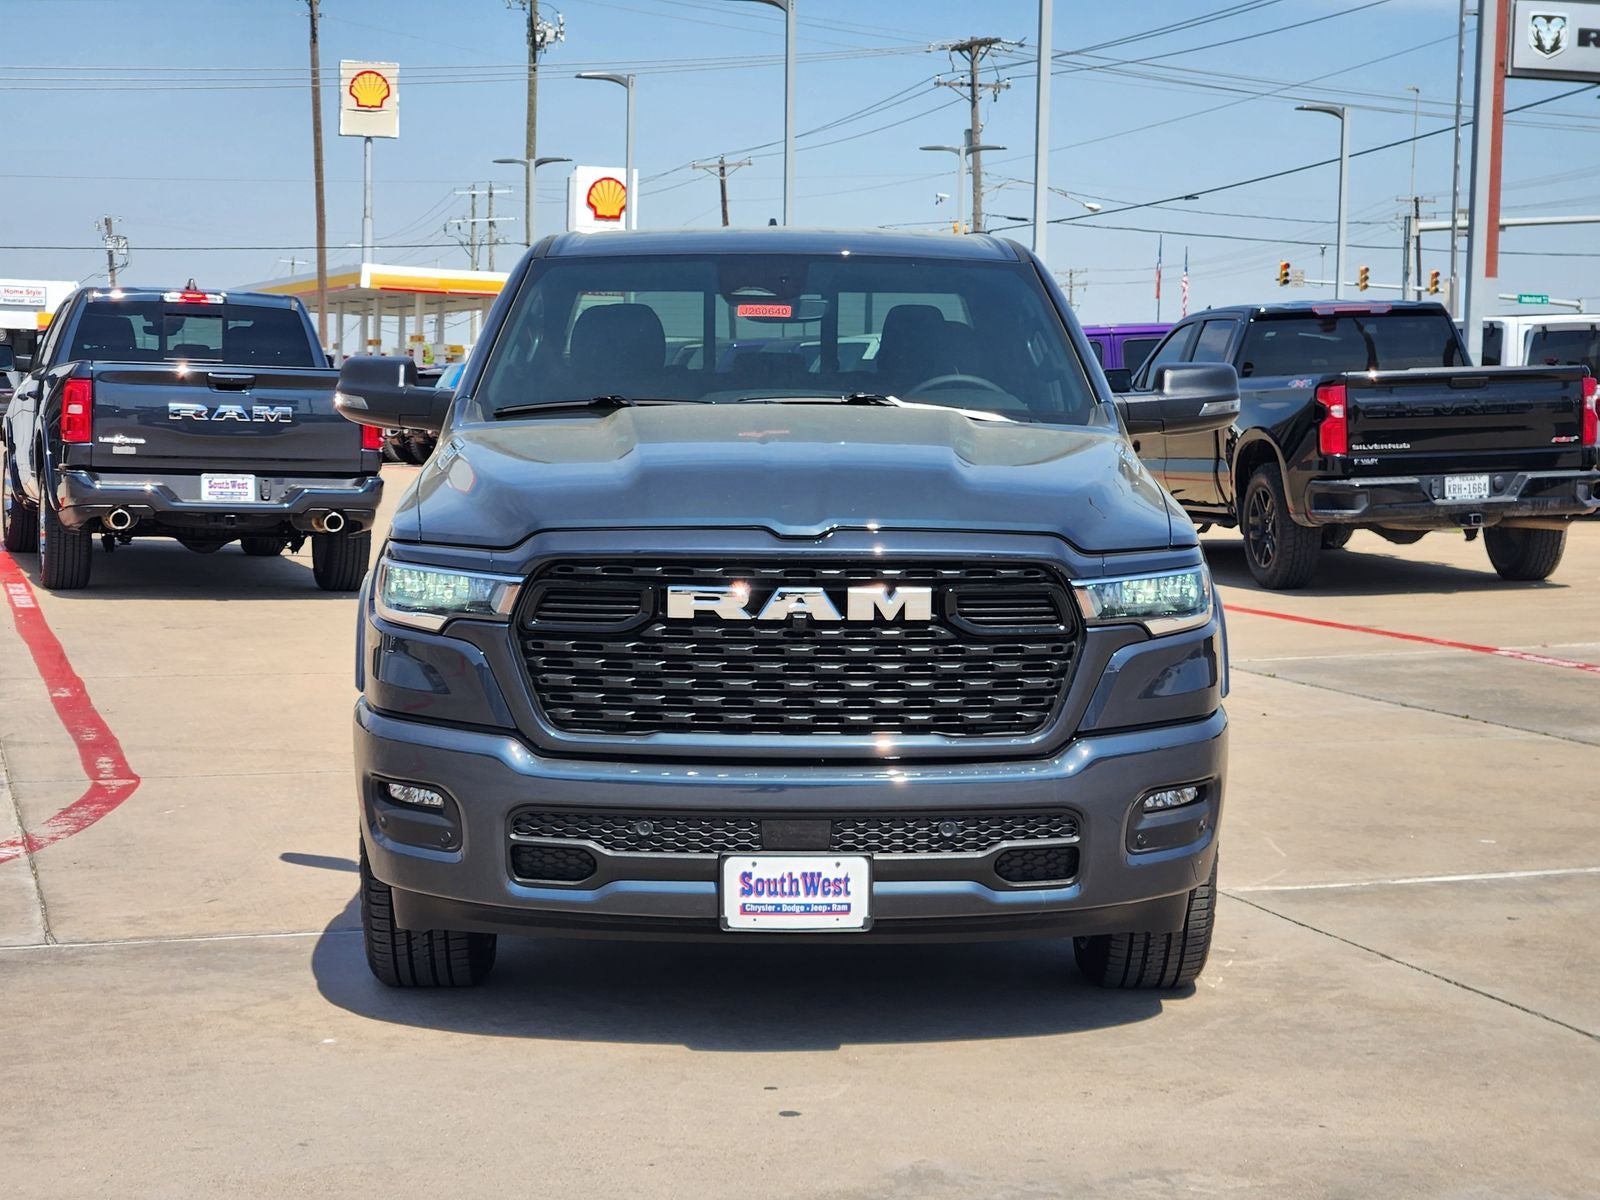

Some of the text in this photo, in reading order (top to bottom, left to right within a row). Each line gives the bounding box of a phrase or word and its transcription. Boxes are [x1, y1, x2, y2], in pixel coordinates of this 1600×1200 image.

[168, 402, 292, 423] RAM
[667, 585, 932, 621] RAM
[745, 904, 775, 913] Chrysler
[831, 904, 848, 912] Ram
